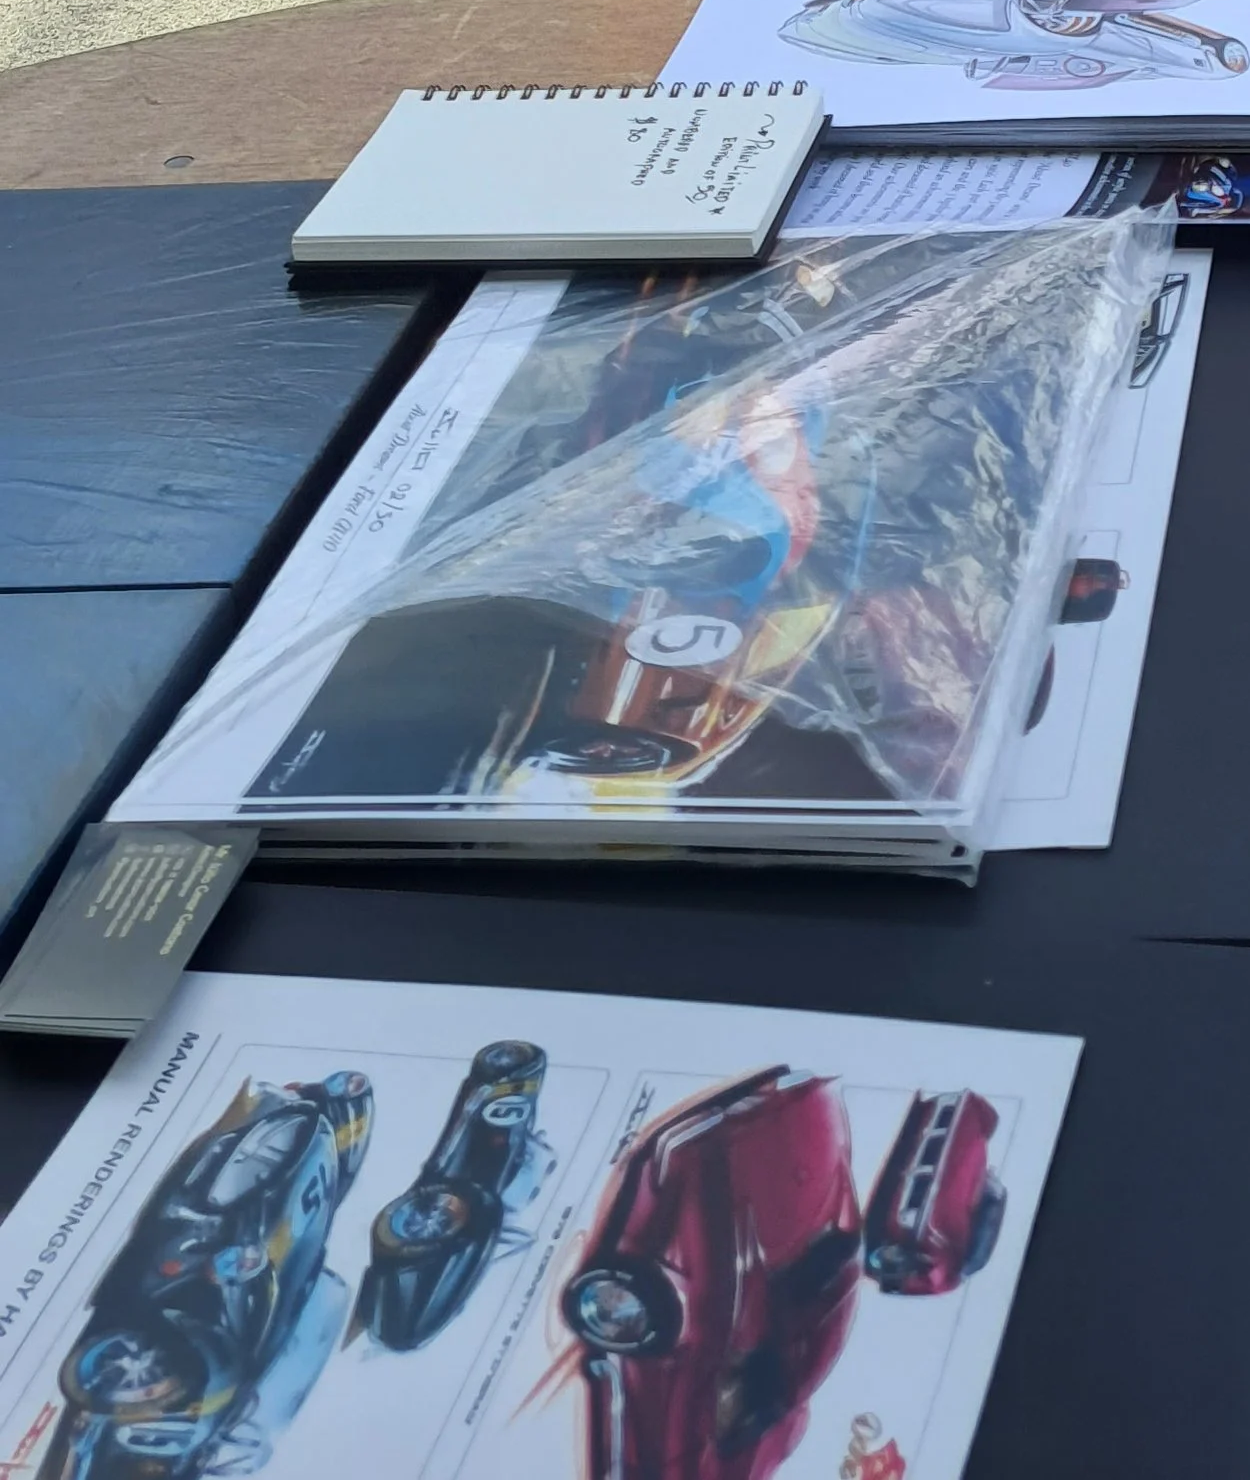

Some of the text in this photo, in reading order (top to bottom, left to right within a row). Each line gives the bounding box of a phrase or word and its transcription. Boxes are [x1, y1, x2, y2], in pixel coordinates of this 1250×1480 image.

[651, 622, 725, 656] 5
[134, 1031, 199, 1117] MANUAL
[38, 1123, 142, 1265] RENDERINGS
[16, 1268, 44, 1301] BY
